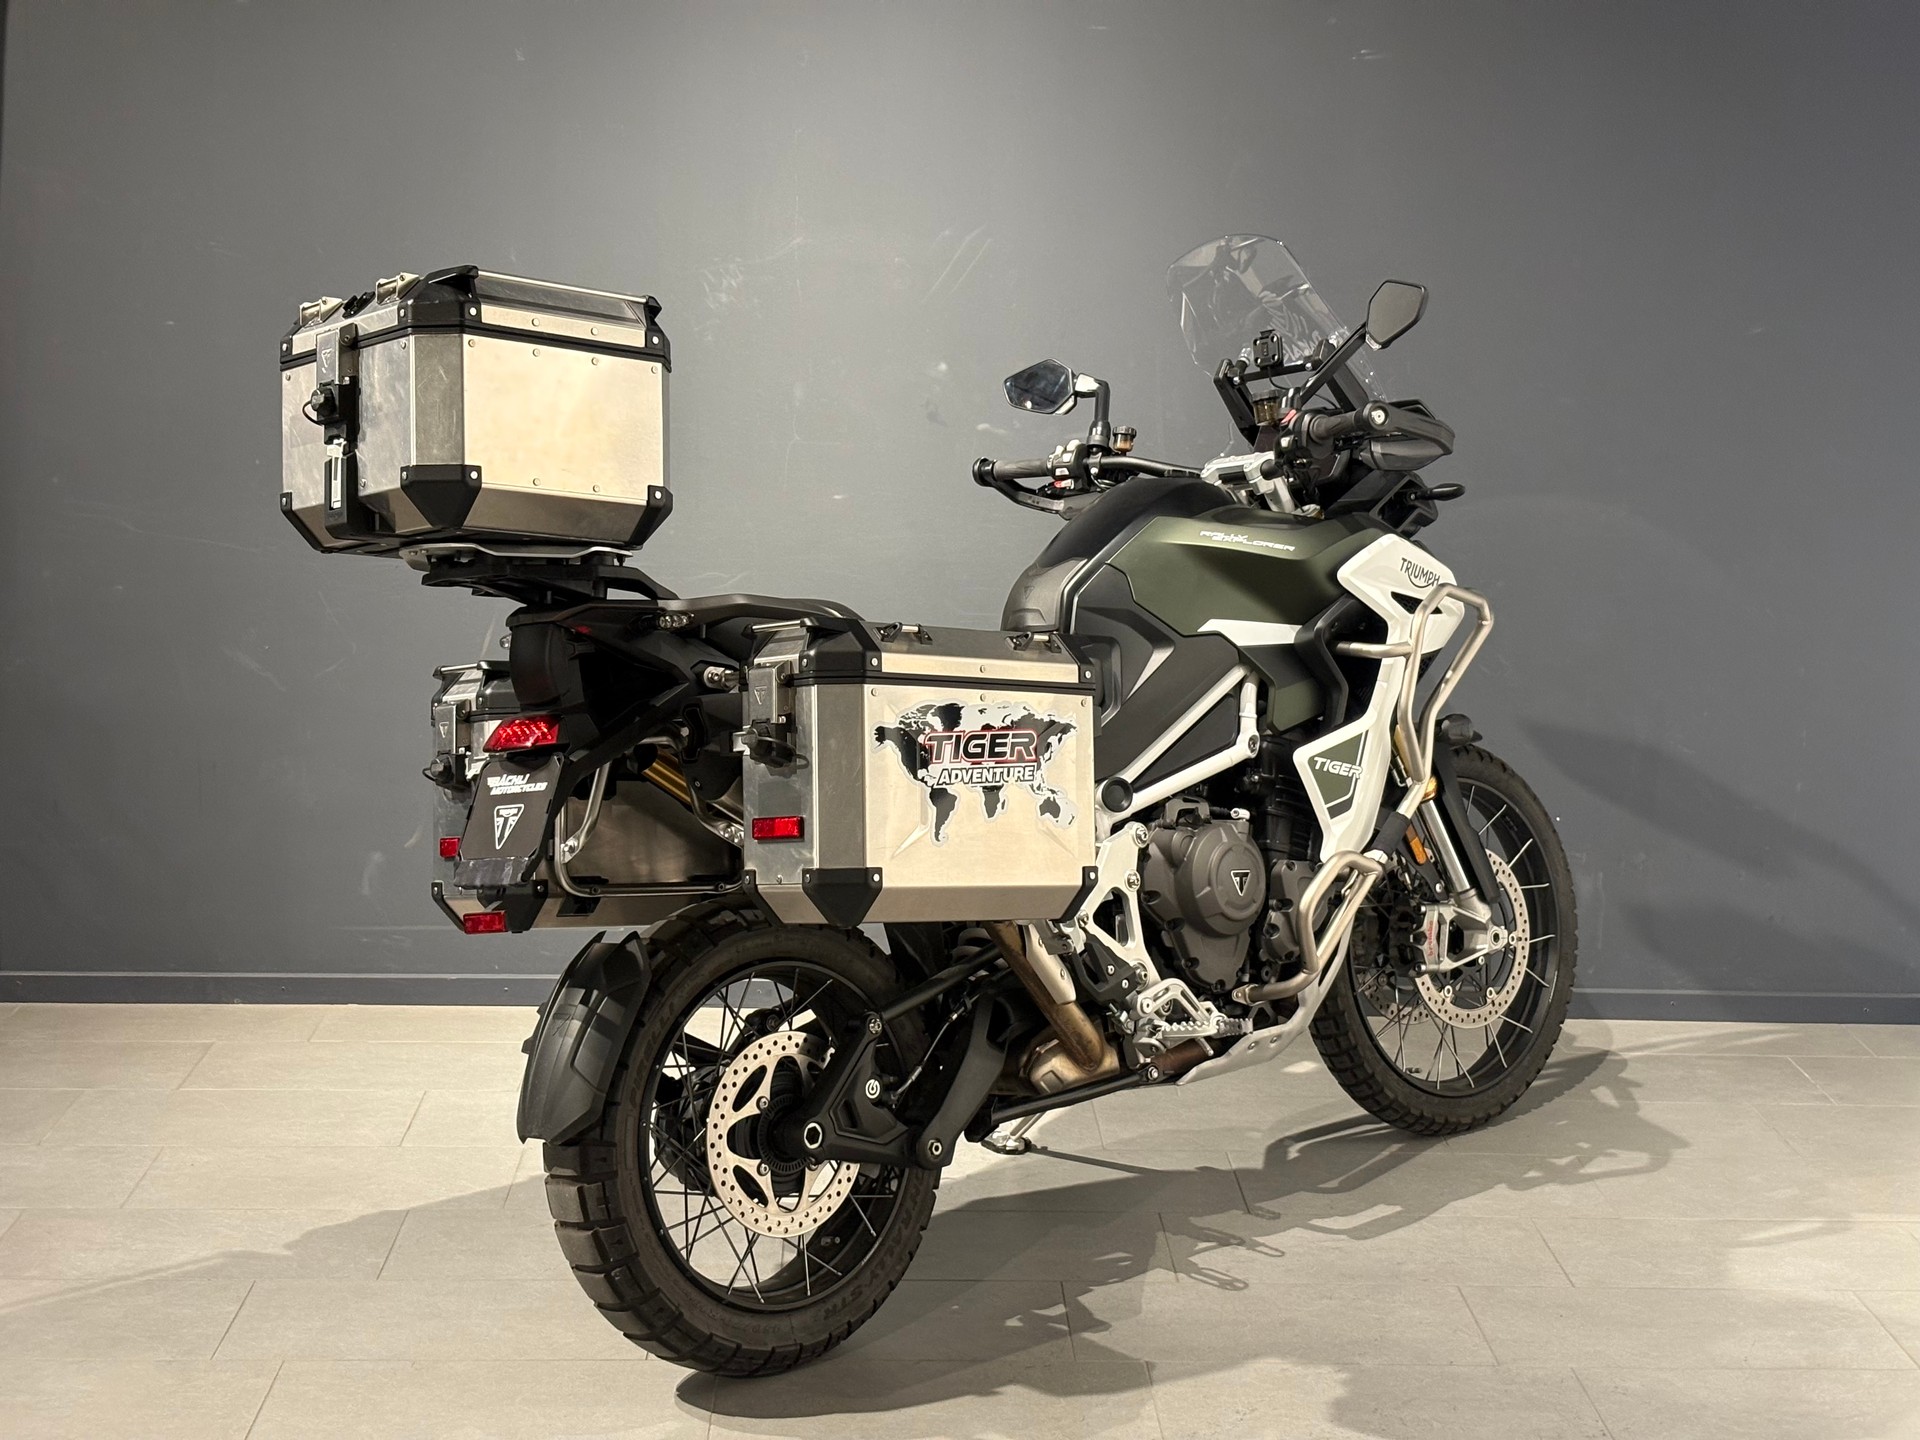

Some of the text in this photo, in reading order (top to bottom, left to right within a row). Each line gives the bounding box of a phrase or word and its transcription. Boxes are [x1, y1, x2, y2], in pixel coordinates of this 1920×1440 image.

[1211, 535, 1296, 552] EXPLORER
[1399, 557, 1440, 588] TRIUMPH
[926, 731, 1038, 764] TIGER
[937, 765, 1036, 785] ADVENTURE
[1313, 756, 1363, 780] TIGER
[490, 782, 548, 795] MOTORCYCLES
[629, 1001, 677, 1109] PIRELLI
